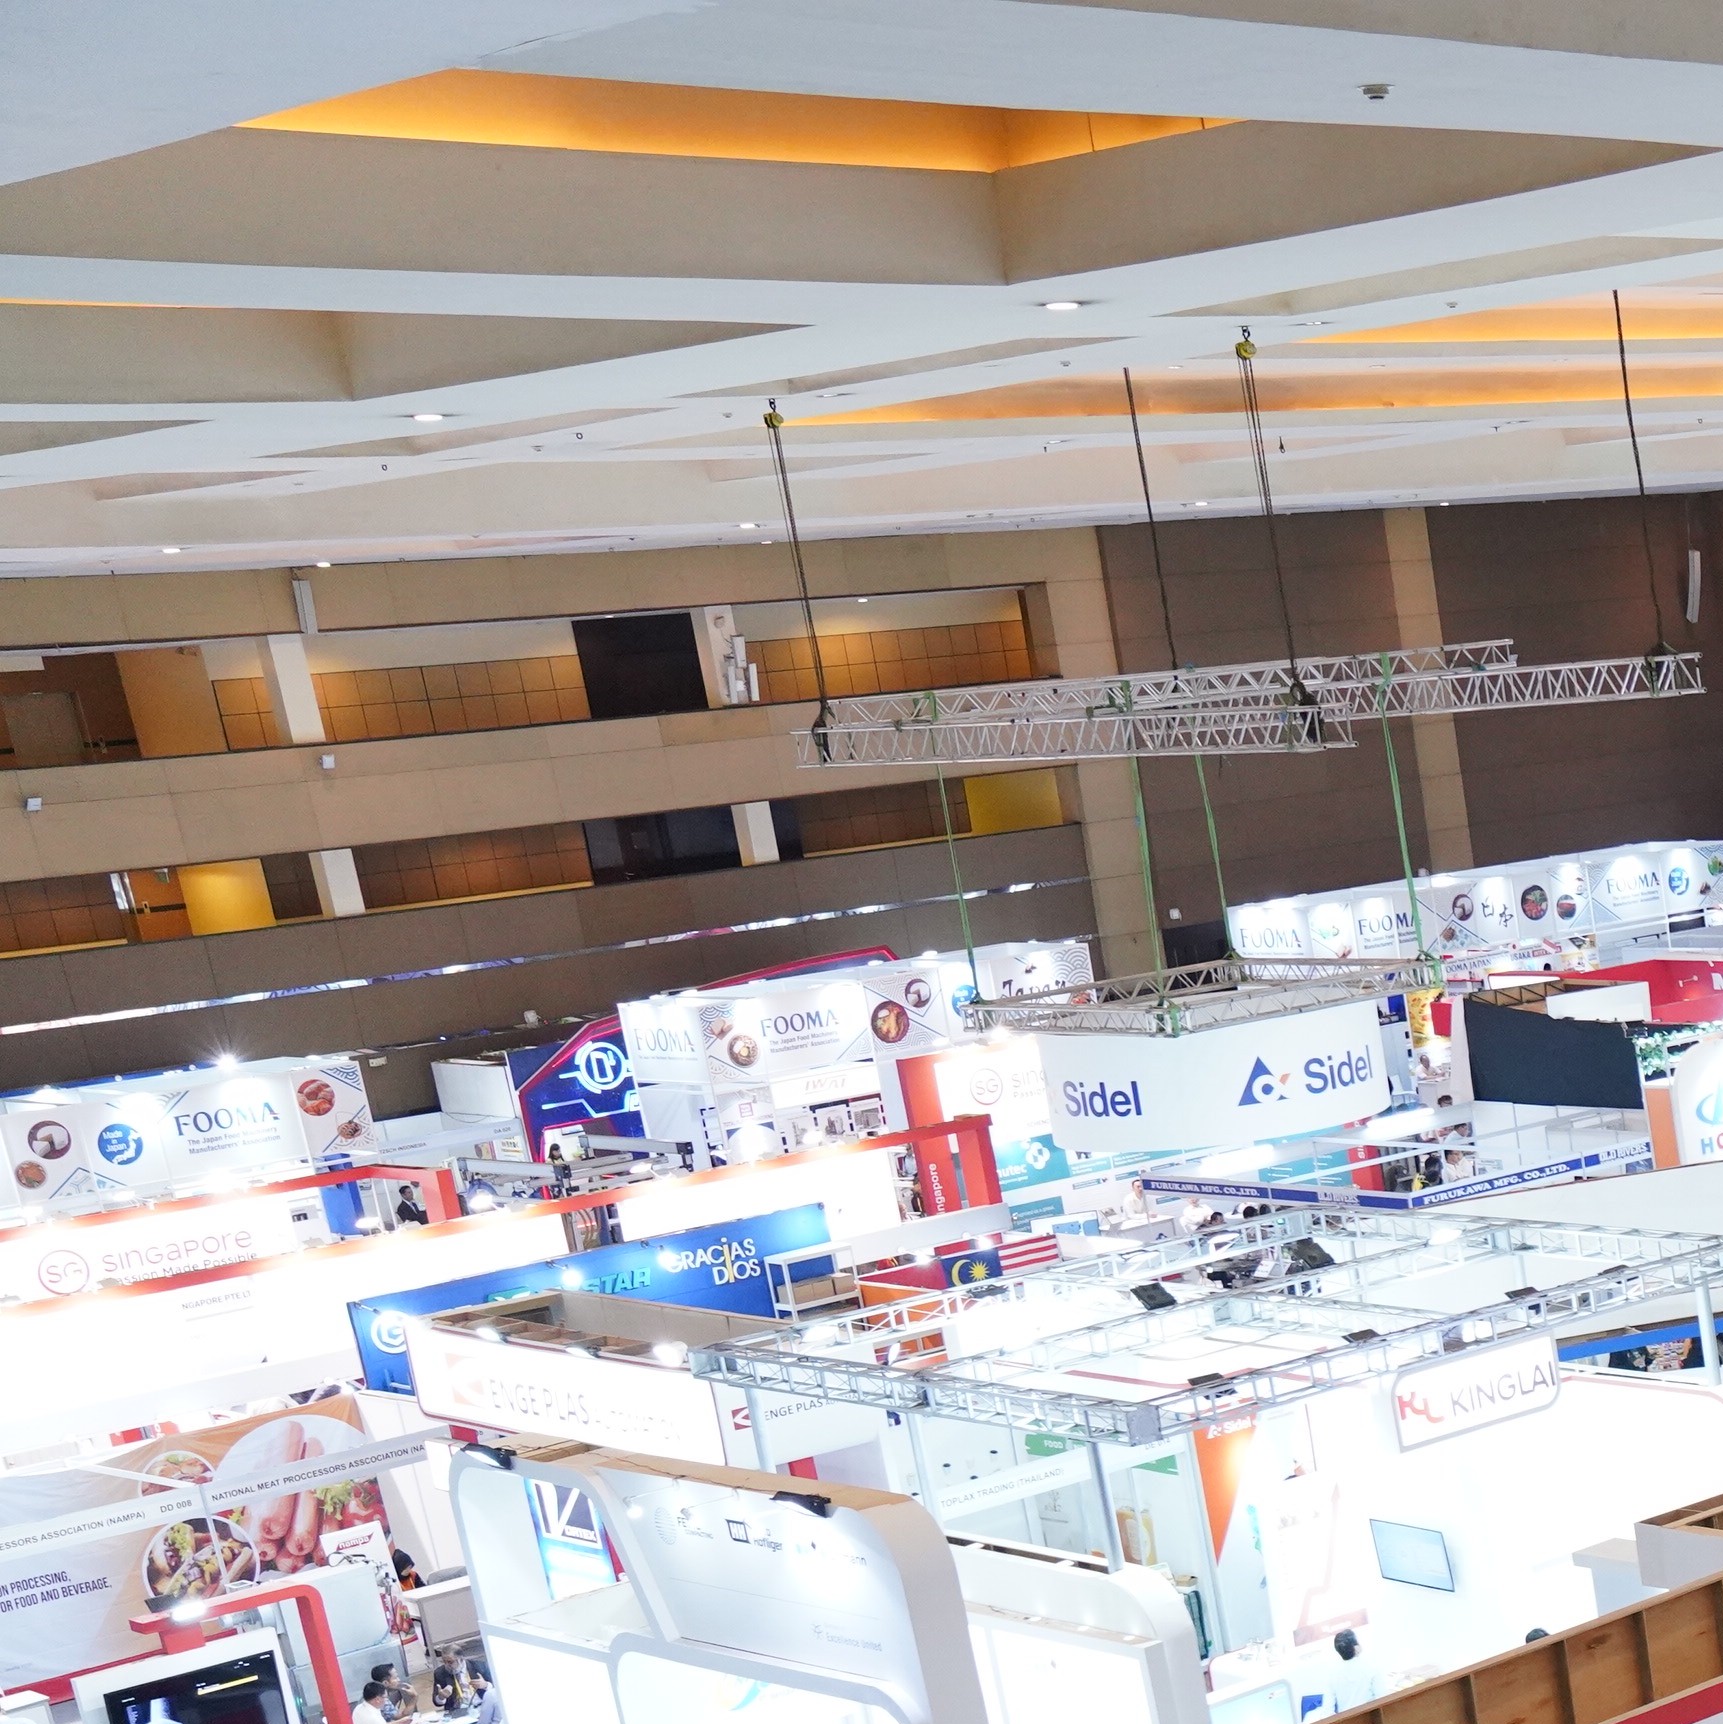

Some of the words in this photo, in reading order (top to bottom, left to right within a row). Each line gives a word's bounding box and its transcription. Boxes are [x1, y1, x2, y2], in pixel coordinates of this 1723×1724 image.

[1606, 871, 1661, 894] FOOMA
[1359, 911, 1416, 936] FOOMA
[1240, 927, 1302, 949] FOOMA
[760, 1009, 839, 1037] FOOMA
[634, 1027, 695, 1052] FOOMA
[1303, 1044, 1374, 1095] Sidel
[1063, 1081, 1143, 1117] Sidel
[174, 1102, 281, 1137] FOOMA
[102, 1130, 123, 1140] Made
[105, 1142, 127, 1153] Japan
[187, 1137, 200, 1147] The
[201, 1133, 223, 1147] Japan
[1150, 1181, 1199, 1194] FURUKAWA
[1201, 1184, 1222, 1195] MFG.
[1423, 1182, 1491, 1206] FURUKAWA
[1494, 1174, 1522, 1188] MFG.
[1451, 1361, 1556, 1418] KINGLAI
[764, 1402, 794, 1421] ENGE
[796, 1397, 824, 1414] PLAS
[1223, 1416, 1252, 1433] Sidel
[211, 1484, 256, 1503] NATIONAL
[257, 1477, 282, 1494] MEAT
[282, 1462, 347, 1488] PROCCESSORS
[348, 1448, 410, 1470] ASSCOCIATION
[40, 1519, 105, 1543] ASSOCIATION
[105, 1510, 147, 1531] (NAMPA)
[160, 1502, 174, 1515] DD
[176, 1499, 192, 1511] 008
[10, 1571, 72, 1594] PROCESSING,
[14, 1595, 38, 1610] FOOD
[40, 1589, 59, 1605] AND
[60, 1577, 113, 1602] BEVERAGE,
